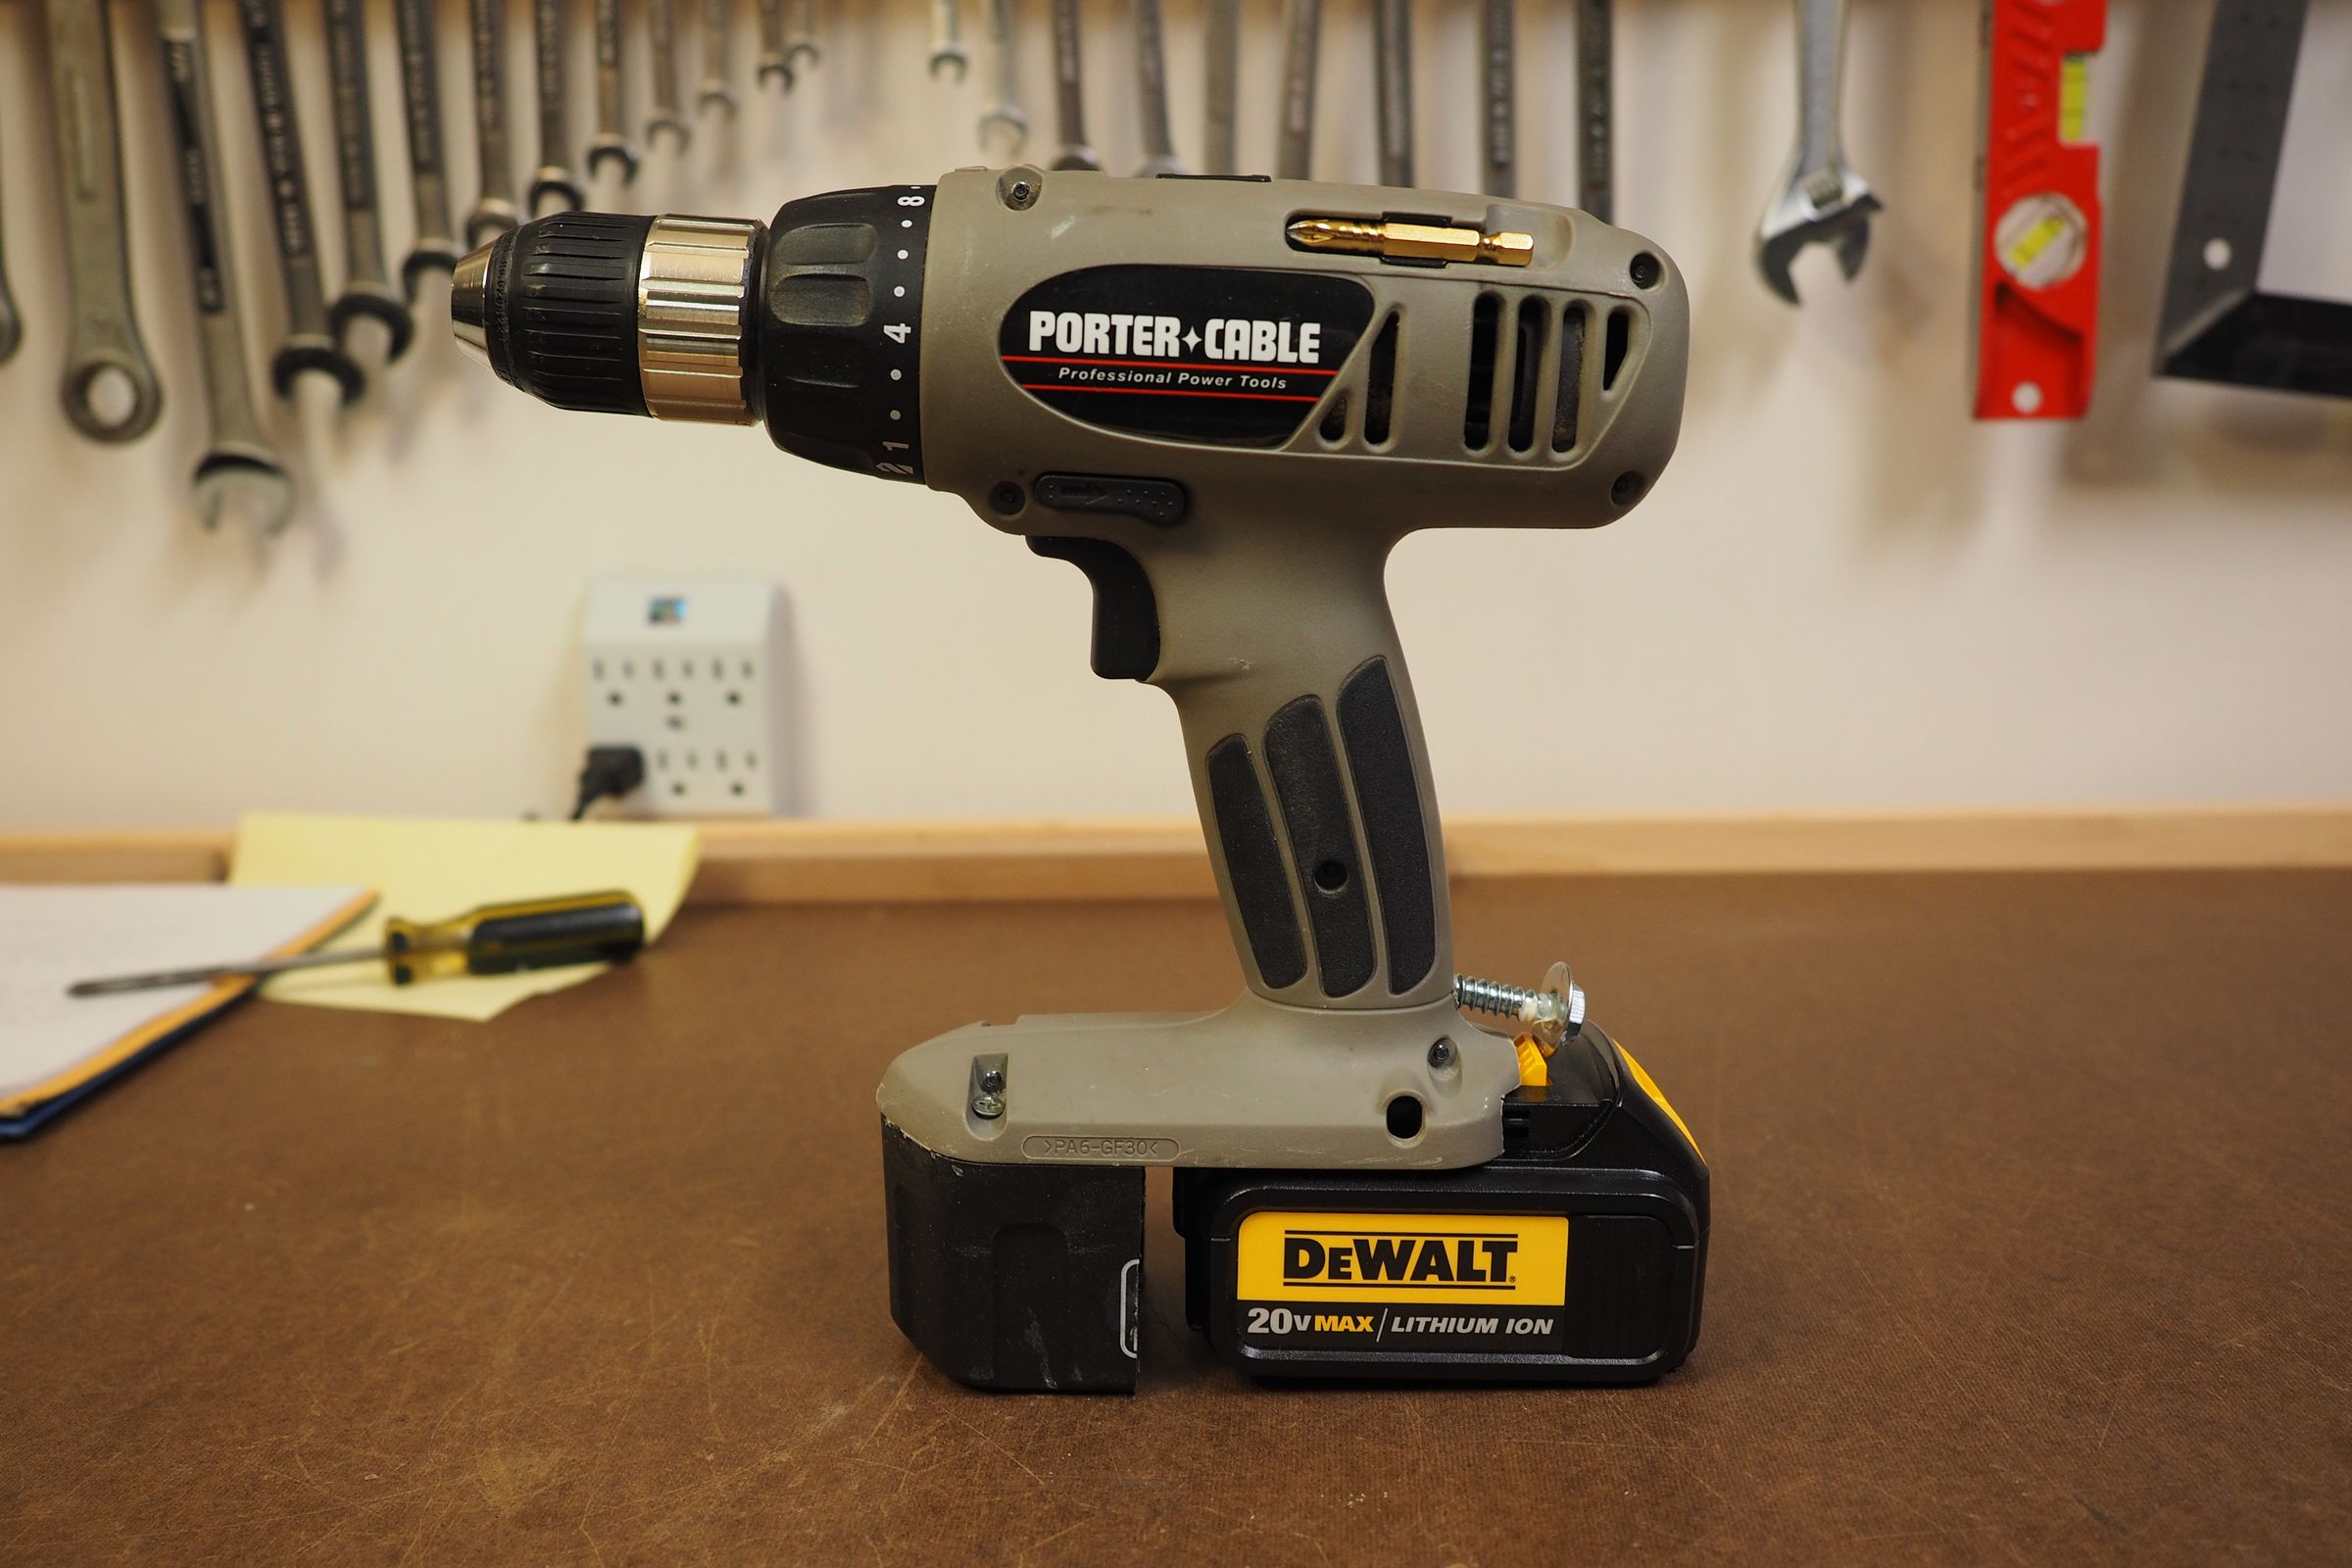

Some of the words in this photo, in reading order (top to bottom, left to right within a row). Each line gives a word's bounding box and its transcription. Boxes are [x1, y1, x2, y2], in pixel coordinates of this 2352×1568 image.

[897, 195, 925, 208] 8
[883, 321, 912, 344] 4
[1029, 310, 1182, 358] PORTER
[1204, 318, 1321, 365] CABLE
[1058, 367, 1172, 385] Professional
[1177, 372, 1233, 387] Power
[1240, 374, 1287, 390] Tools
[1391, 1315, 1496, 1335] LITHIUM
[1504, 1317, 1554, 1336] ION
